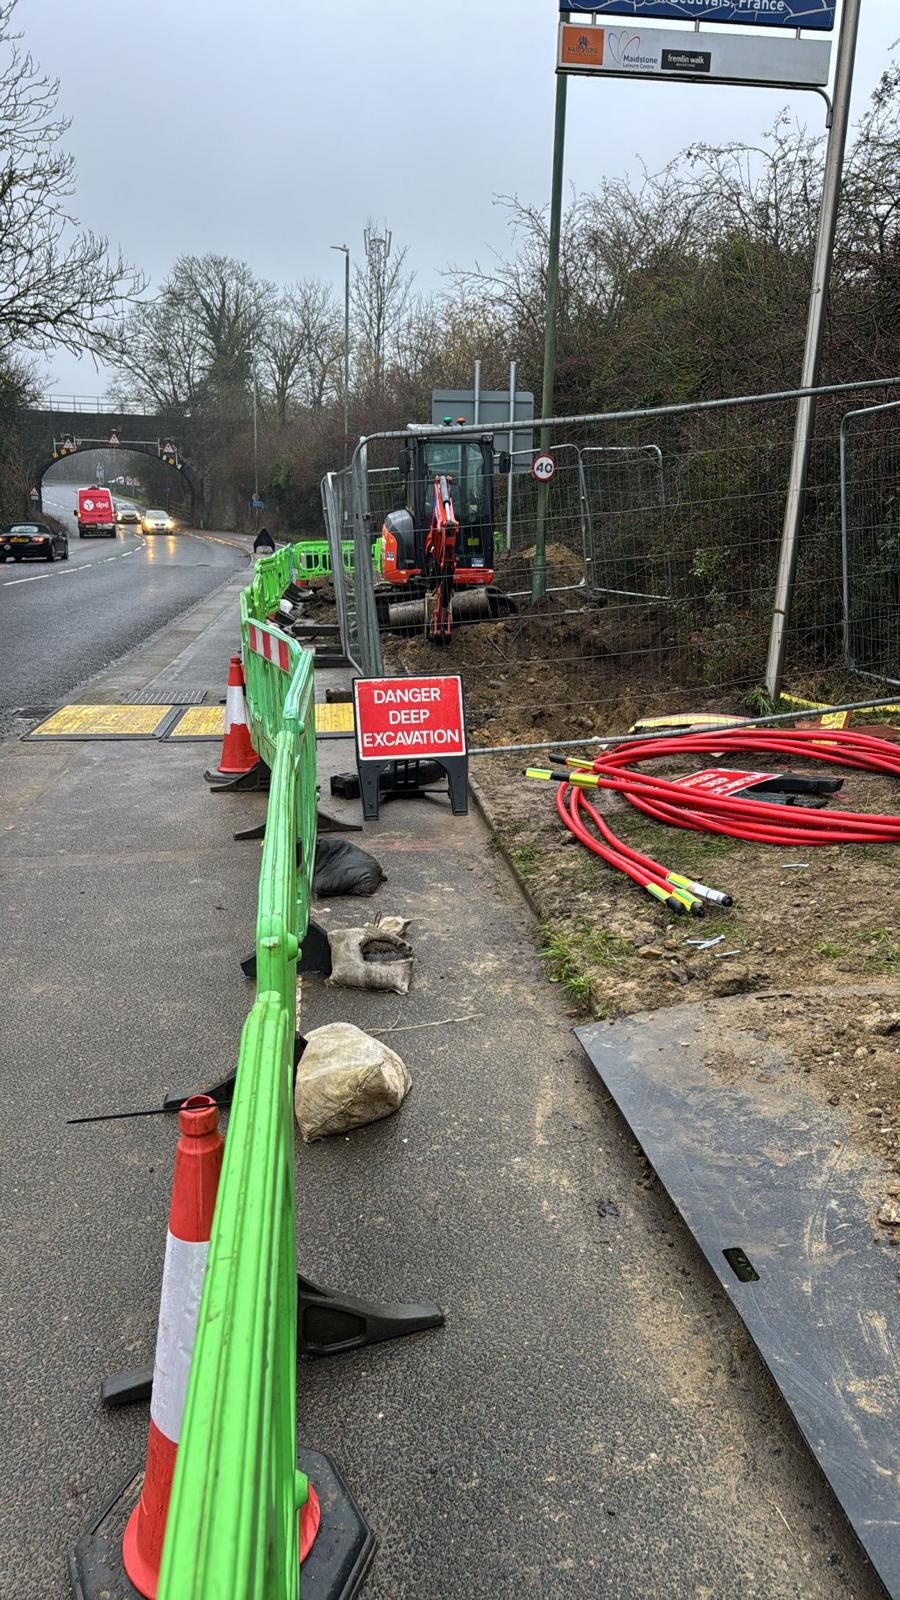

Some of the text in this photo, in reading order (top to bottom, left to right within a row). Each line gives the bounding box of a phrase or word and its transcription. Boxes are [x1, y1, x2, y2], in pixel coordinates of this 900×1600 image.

[623, 54, 658, 64] Maidstone
[536, 462, 553, 473] 40
[95, 501, 109, 509] dpd
[373, 687, 441, 704] DANGER
[388, 709, 430, 725] DEEP
[363, 729, 460, 747] EXCAVATION
